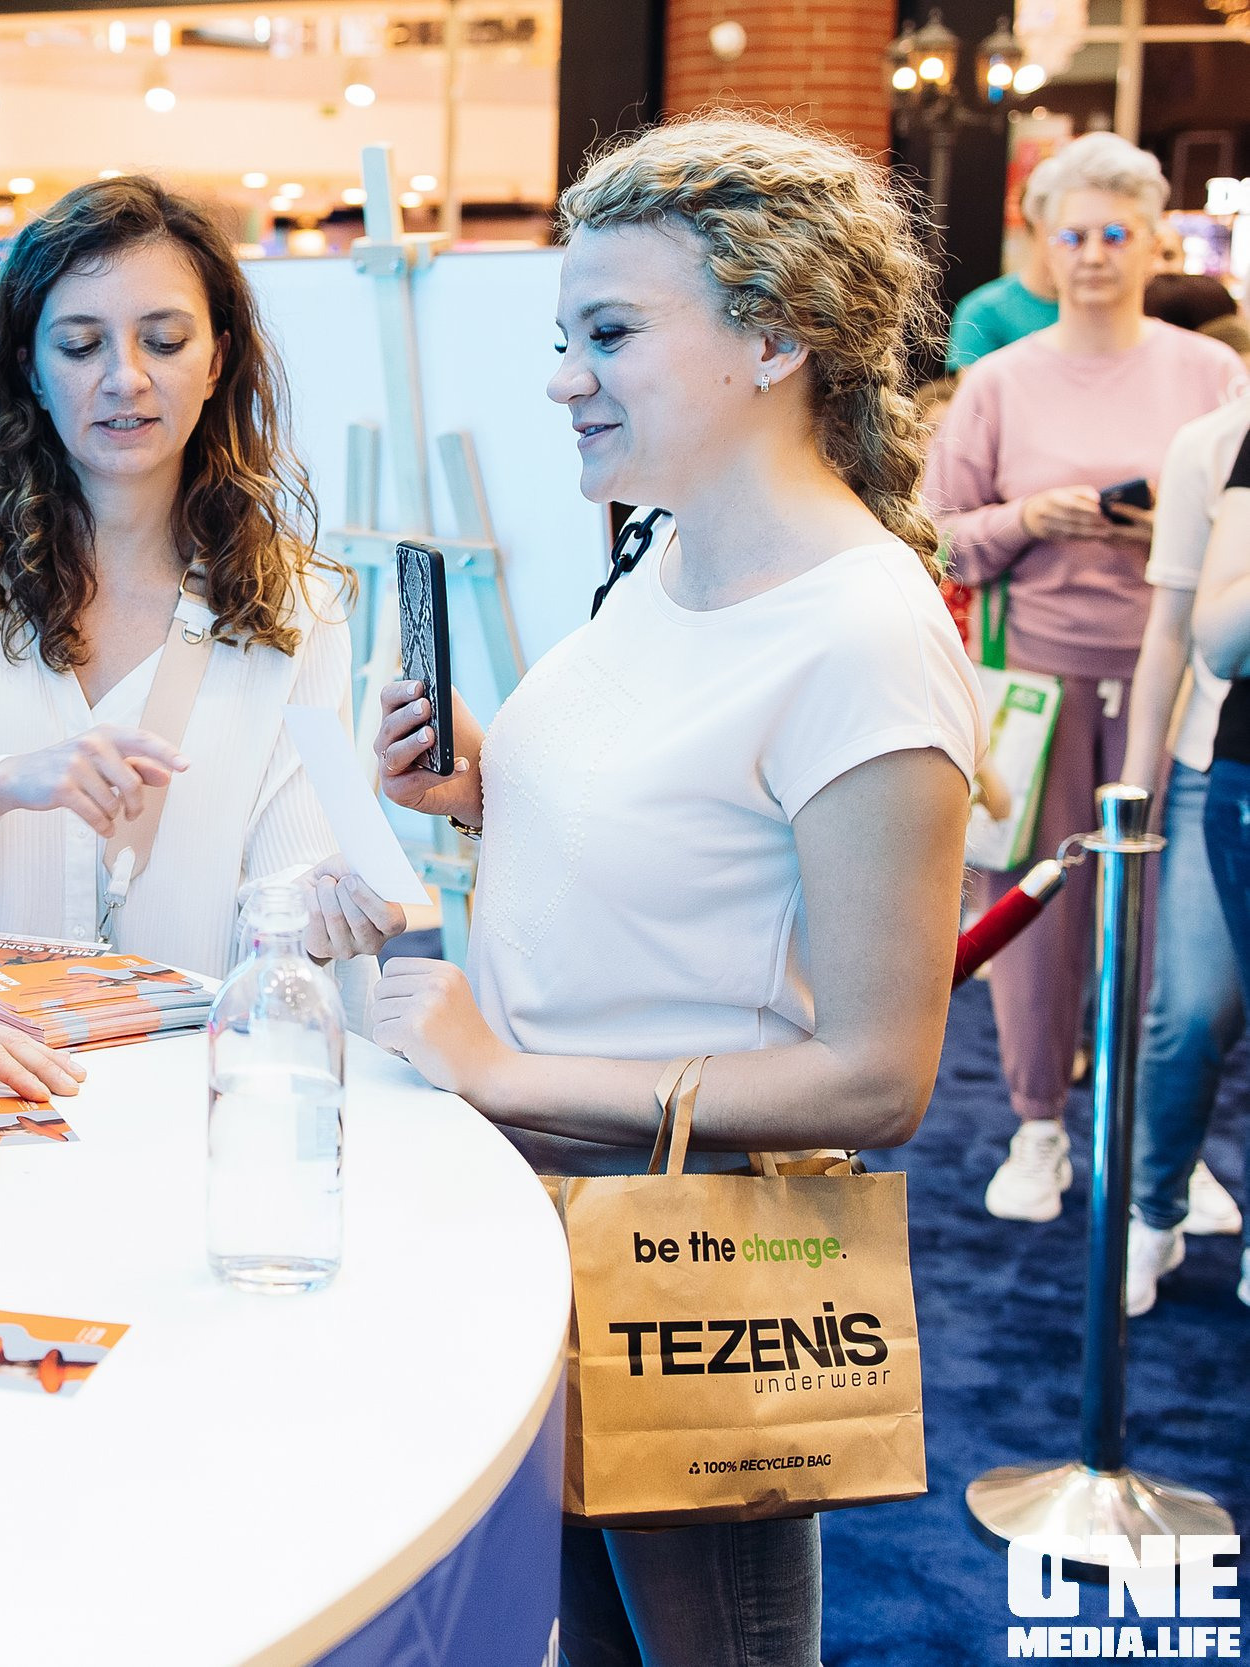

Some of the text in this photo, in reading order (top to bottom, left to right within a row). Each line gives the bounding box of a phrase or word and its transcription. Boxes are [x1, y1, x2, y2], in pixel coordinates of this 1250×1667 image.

[633, 1230, 848, 1269] be the change.
[754, 1368, 891, 1394] underwear
[703, 1454, 832, 1474] 100% RECYCLED BAG
